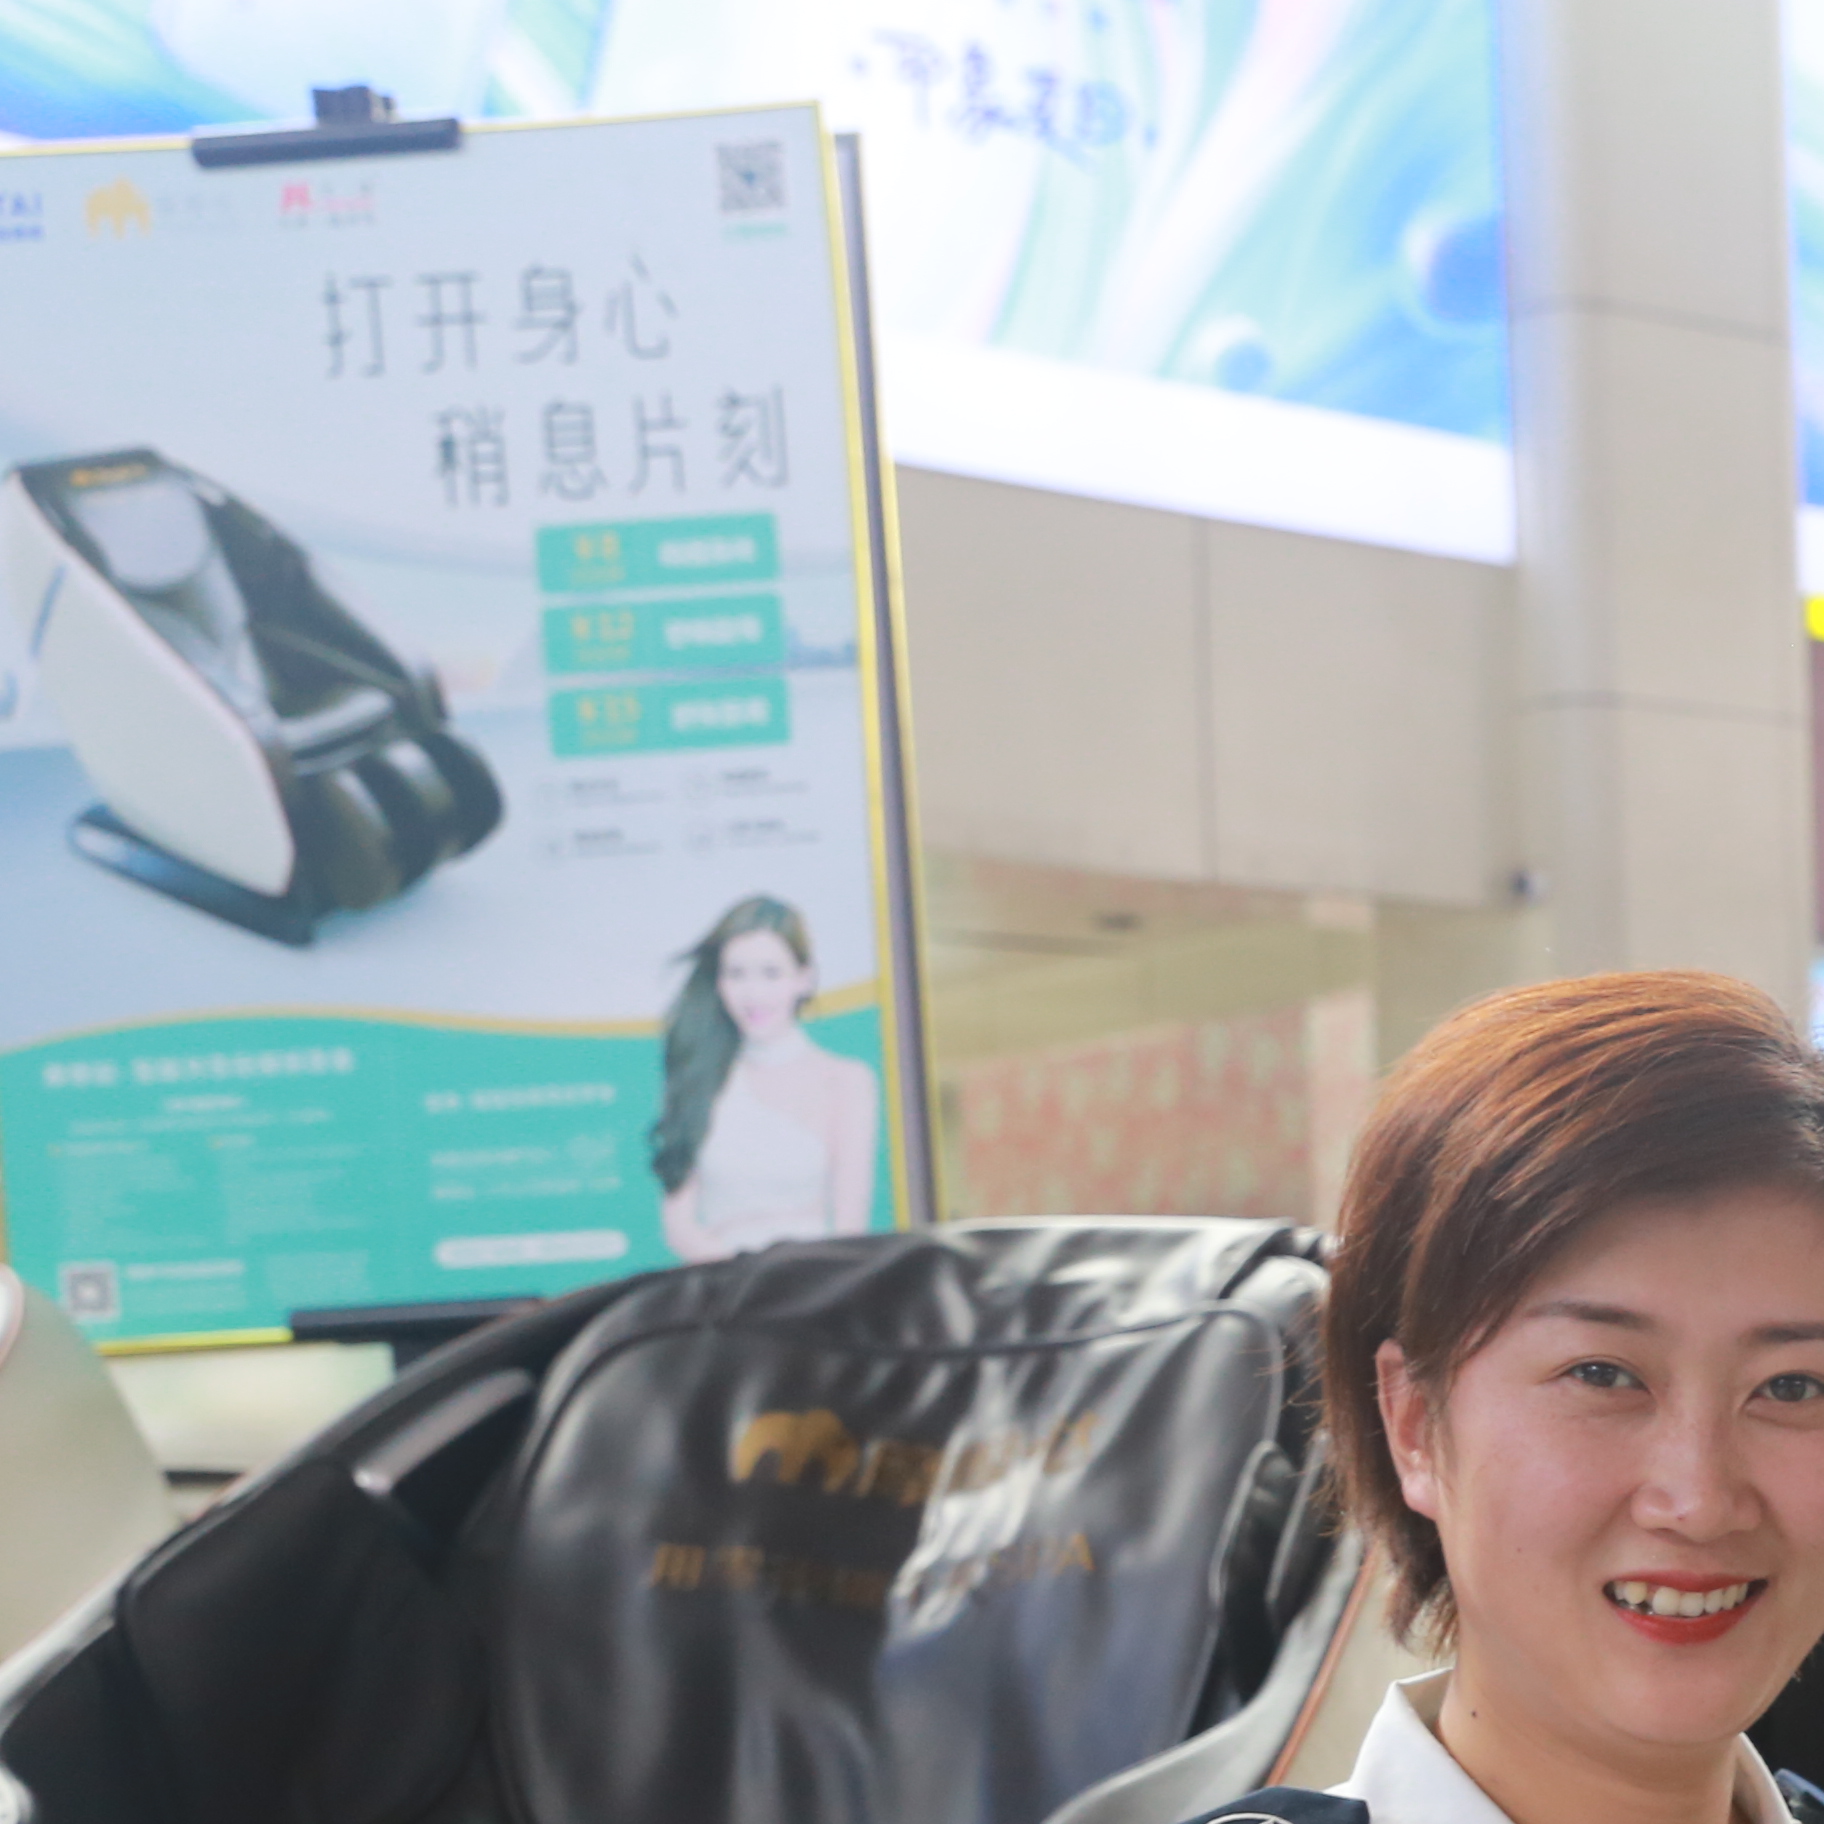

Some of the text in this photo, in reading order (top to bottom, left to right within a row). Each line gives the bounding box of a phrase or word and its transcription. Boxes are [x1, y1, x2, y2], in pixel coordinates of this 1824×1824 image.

[322, 255, 681, 380] 打开身心
[433, 386, 792, 511] 稍息片刻
